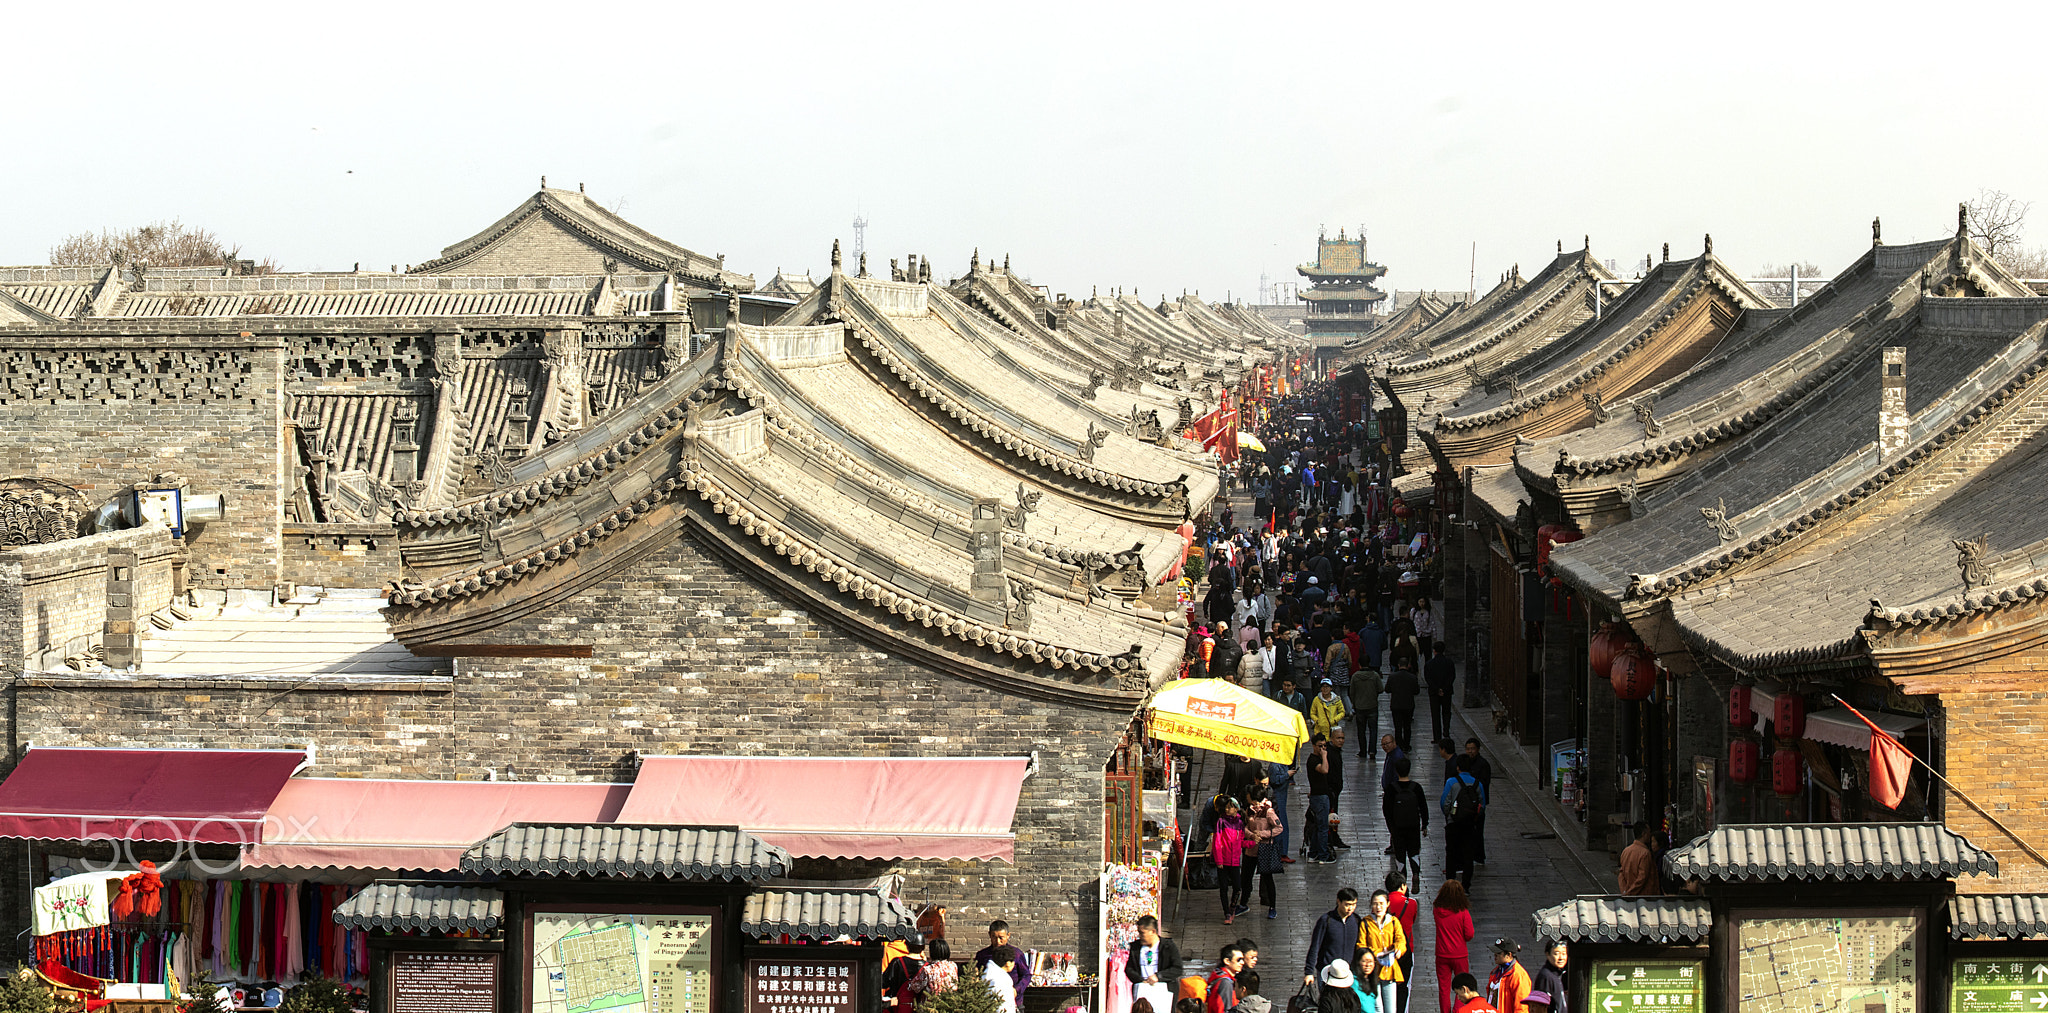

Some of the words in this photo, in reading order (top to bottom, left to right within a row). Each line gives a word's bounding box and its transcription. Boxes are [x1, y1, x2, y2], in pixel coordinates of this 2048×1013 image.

[1223, 734, 1281, 752] 400-000-3943
[758, 965, 848, 977] 创建国家卫生县城
[1632, 967, 1693, 978] 县衙
[1964, 963, 2023, 974] 南大街
[758, 980, 848, 992] 构建文明和谐社会
[1964, 990, 2023, 1001] 文庙
